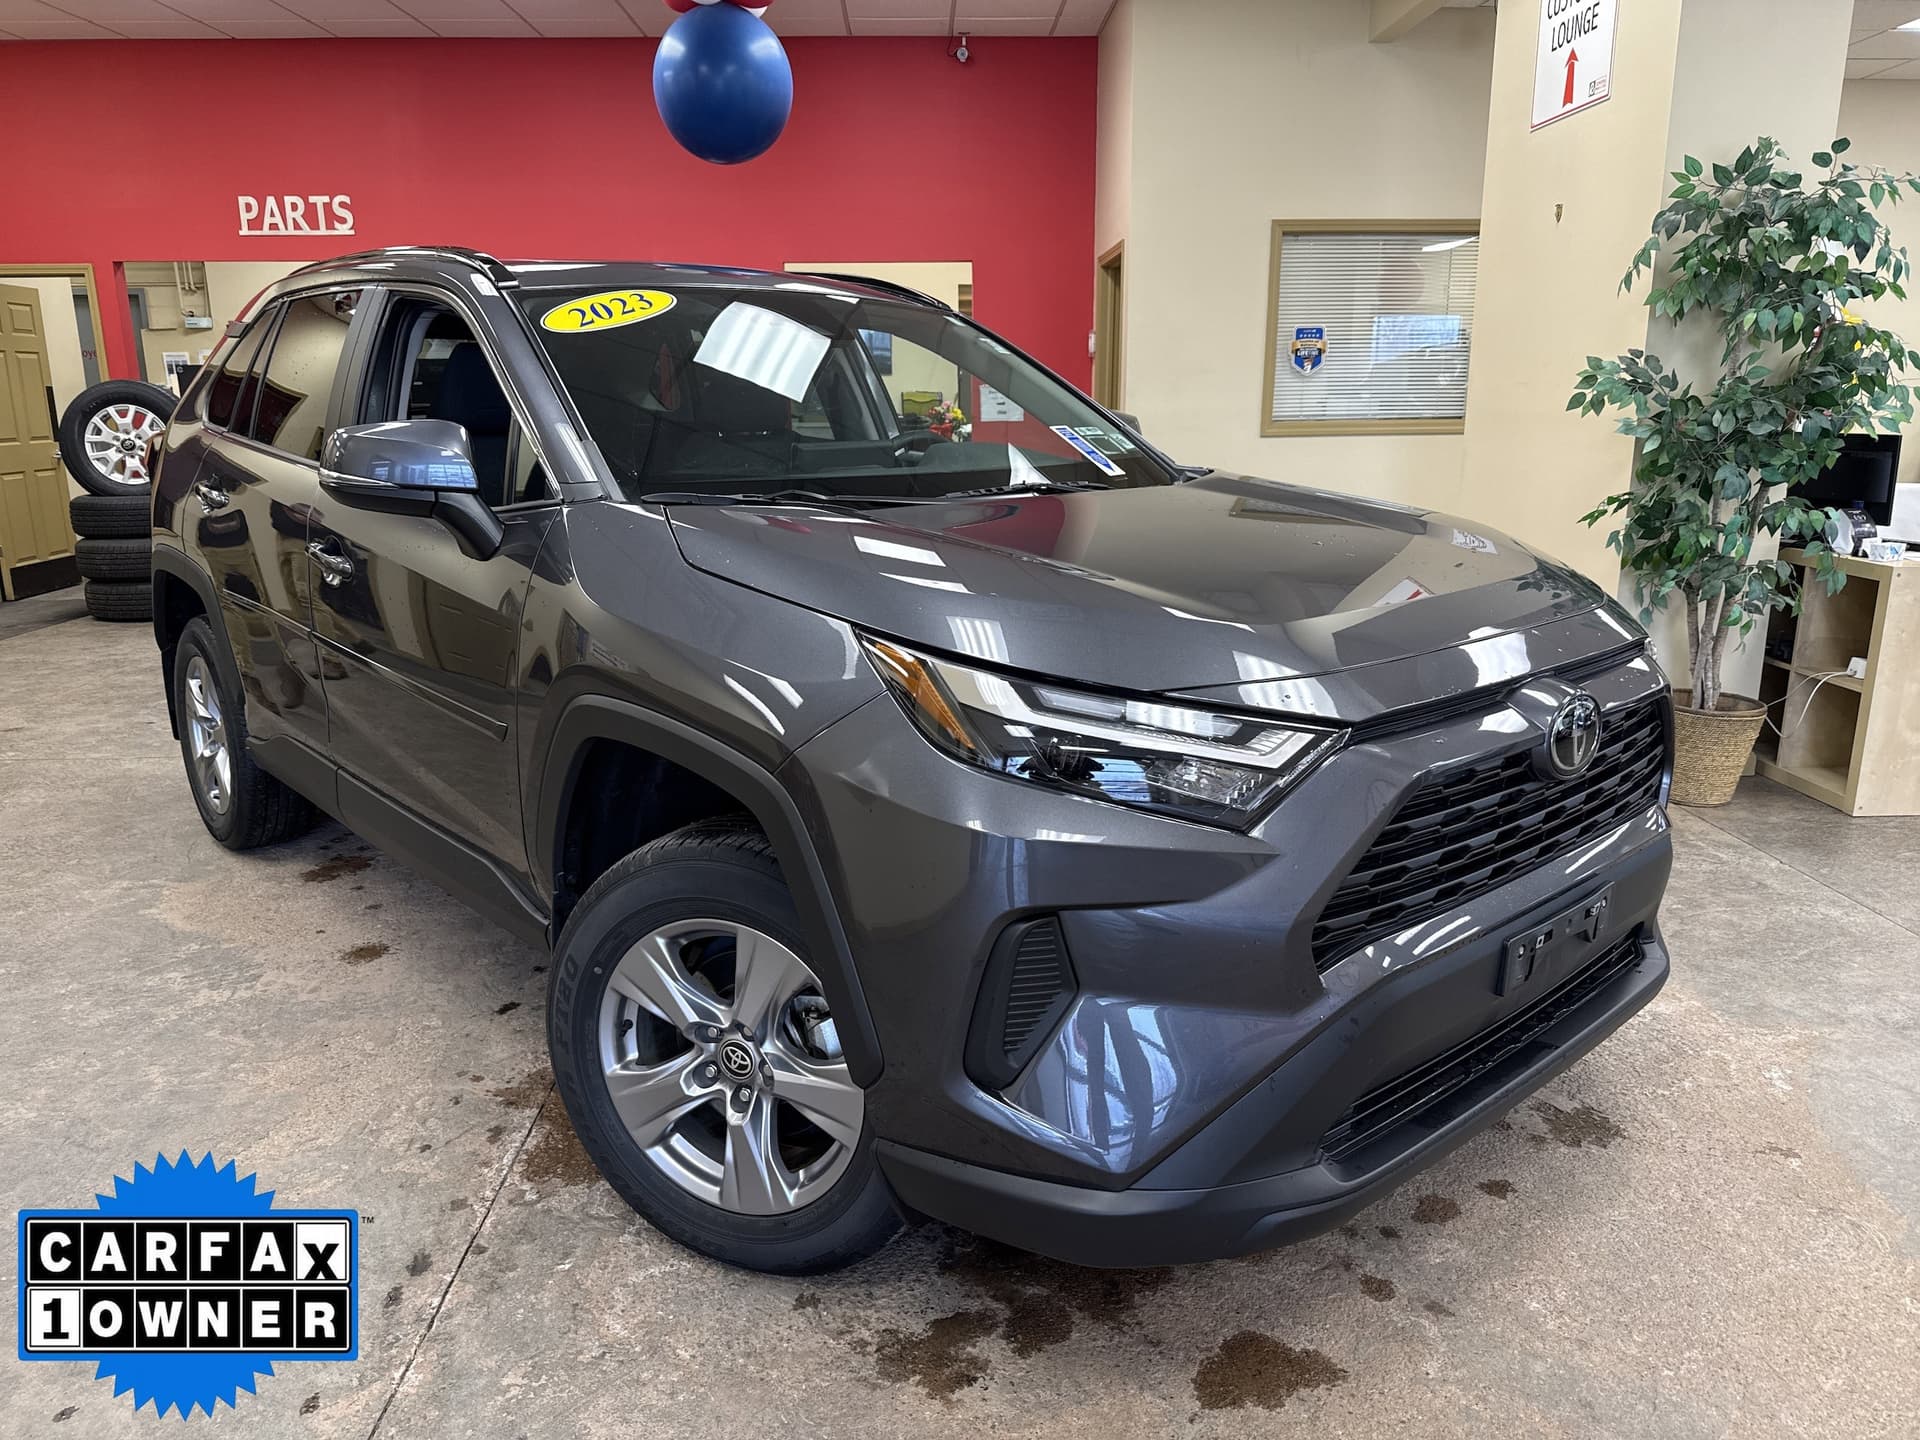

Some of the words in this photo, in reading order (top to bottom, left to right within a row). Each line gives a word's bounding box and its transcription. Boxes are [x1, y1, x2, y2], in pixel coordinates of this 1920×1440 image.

[1551, 1, 1600, 52] LOUNGE
[238, 195, 354, 233] PARTS
[568, 293, 653, 327] 2023
